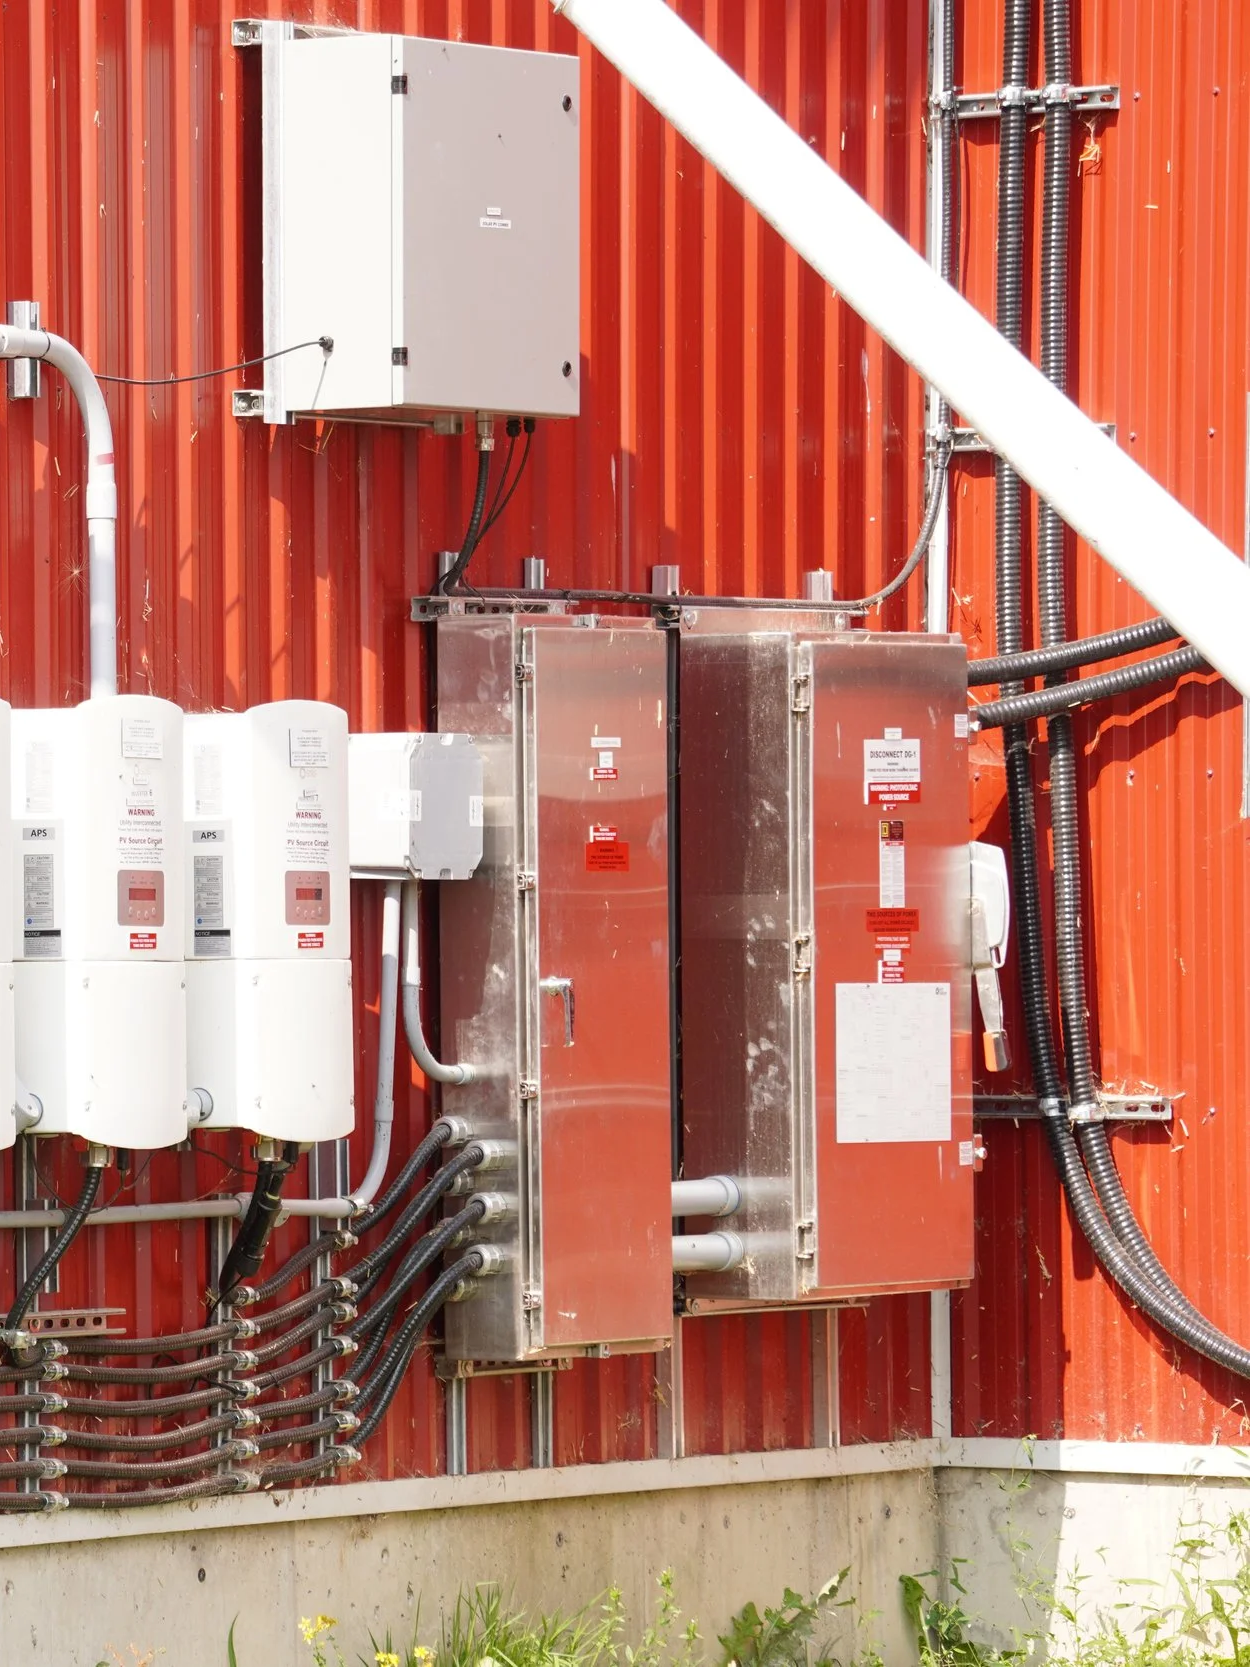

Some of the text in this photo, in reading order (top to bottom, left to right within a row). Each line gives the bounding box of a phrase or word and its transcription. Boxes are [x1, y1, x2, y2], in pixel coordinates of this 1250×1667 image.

[870, 750, 903, 759] DISCONNECT
[890, 783, 918, 792] PHOTOVOLTAIC
[878, 793, 910, 801] POWER SOURCE
[128, 809, 155, 817] WARNING
[296, 811, 322, 820] WARNING
[30, 829, 47, 837] APS
[201, 832, 217, 840] APS
[296, 839, 313, 847] Source
[314, 839, 329, 847] Circuit
